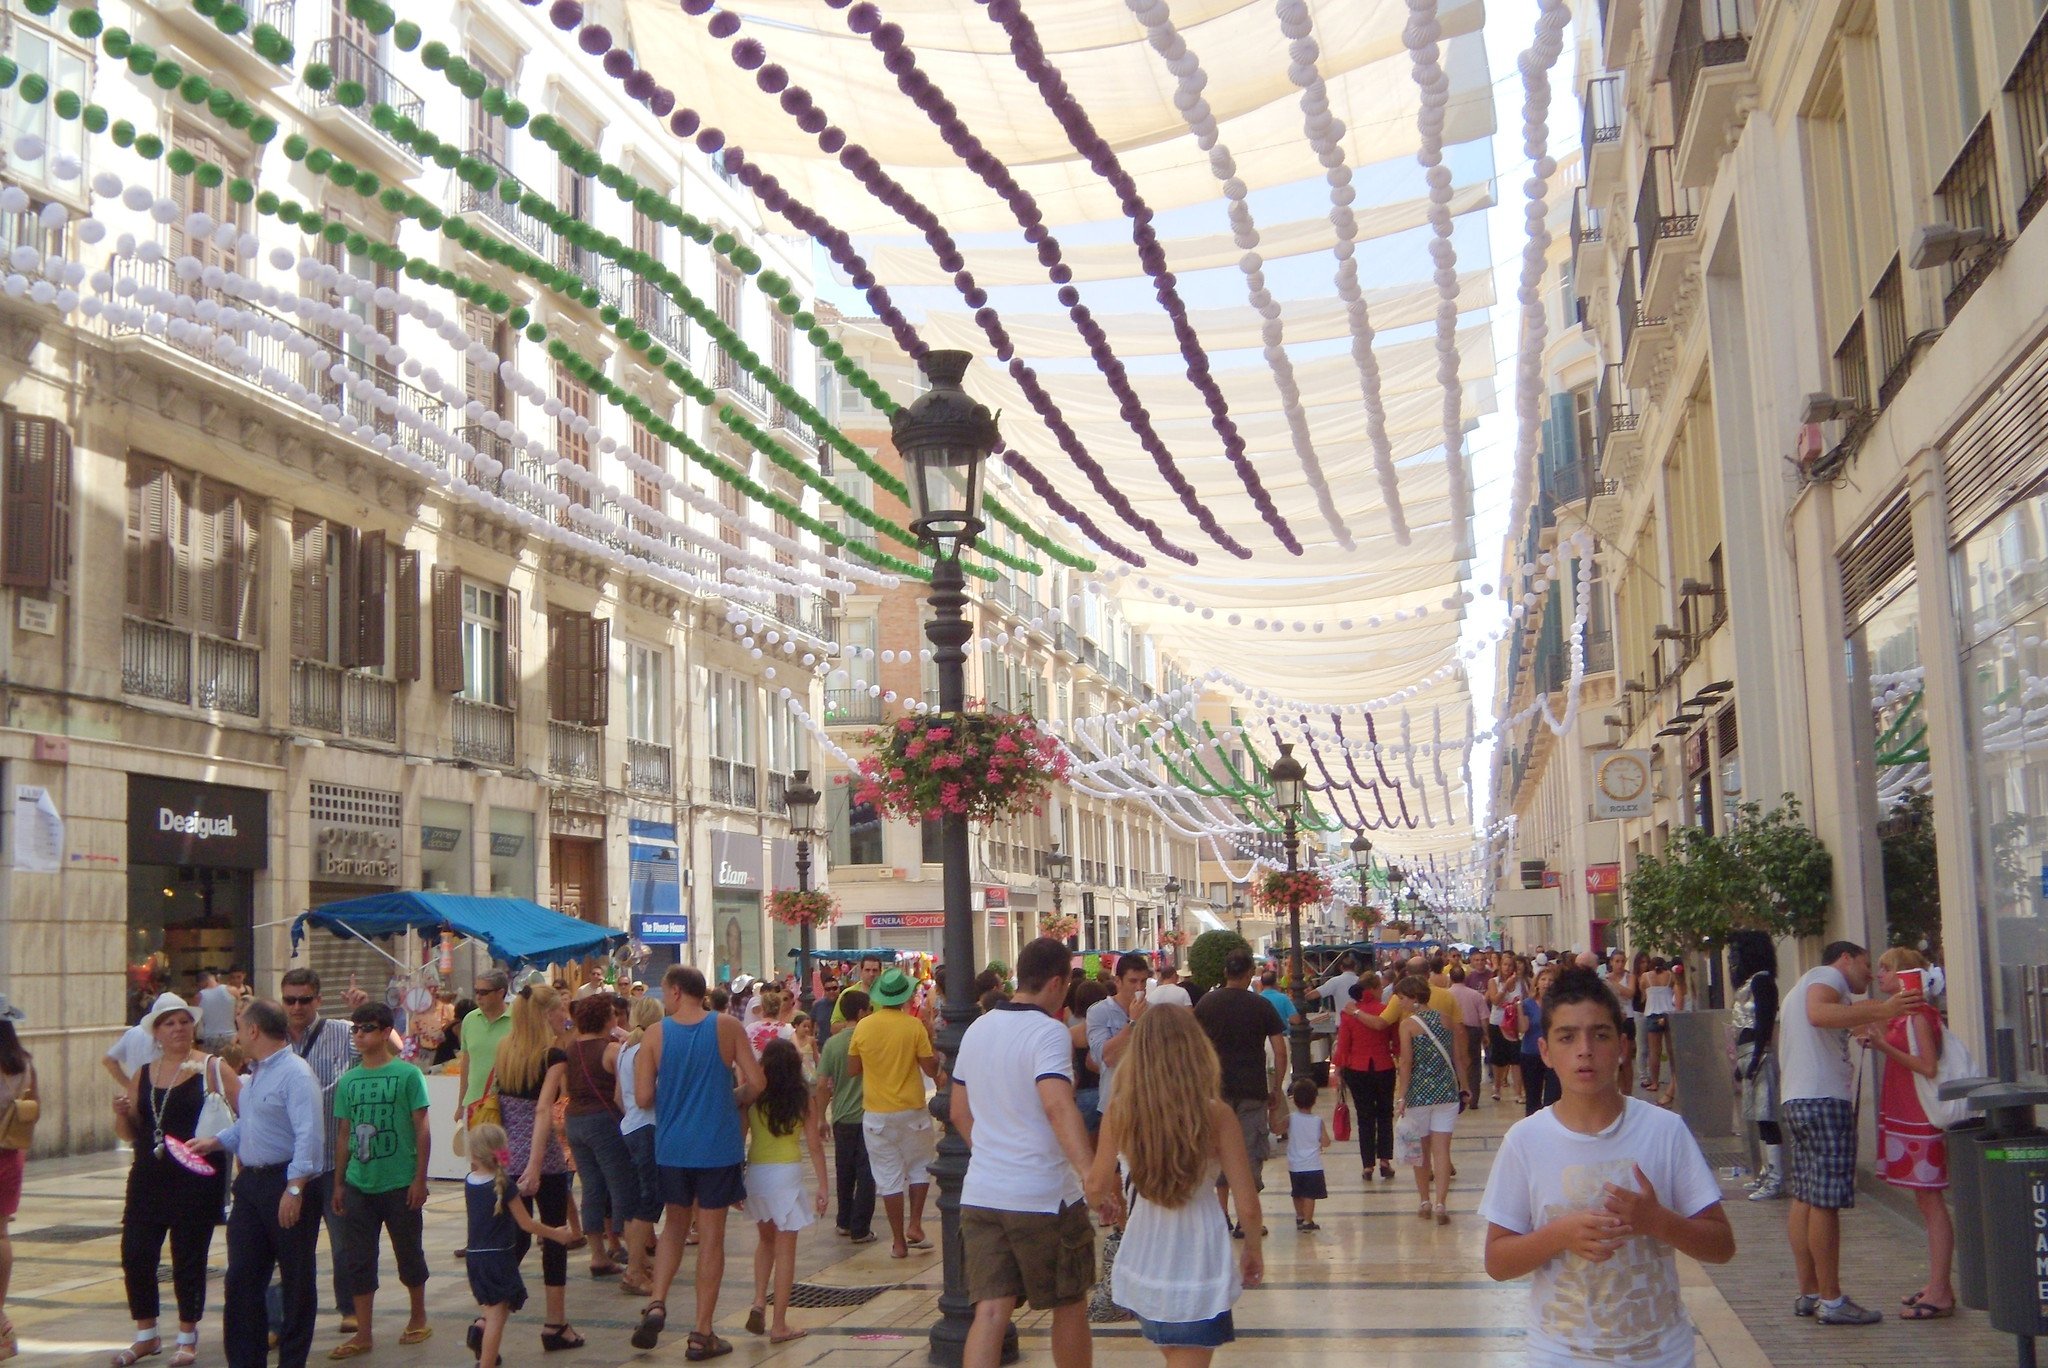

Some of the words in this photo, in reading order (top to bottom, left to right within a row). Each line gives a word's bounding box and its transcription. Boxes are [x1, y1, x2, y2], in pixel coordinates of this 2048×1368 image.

[1610, 804, 1639, 812] ROLEX
[719, 860, 748, 885] Etam
[871, 916, 906, 926] GENERAL
[642, 921, 653, 933] The
[653, 922, 669, 933] Phone
[669, 922, 686, 933] House
